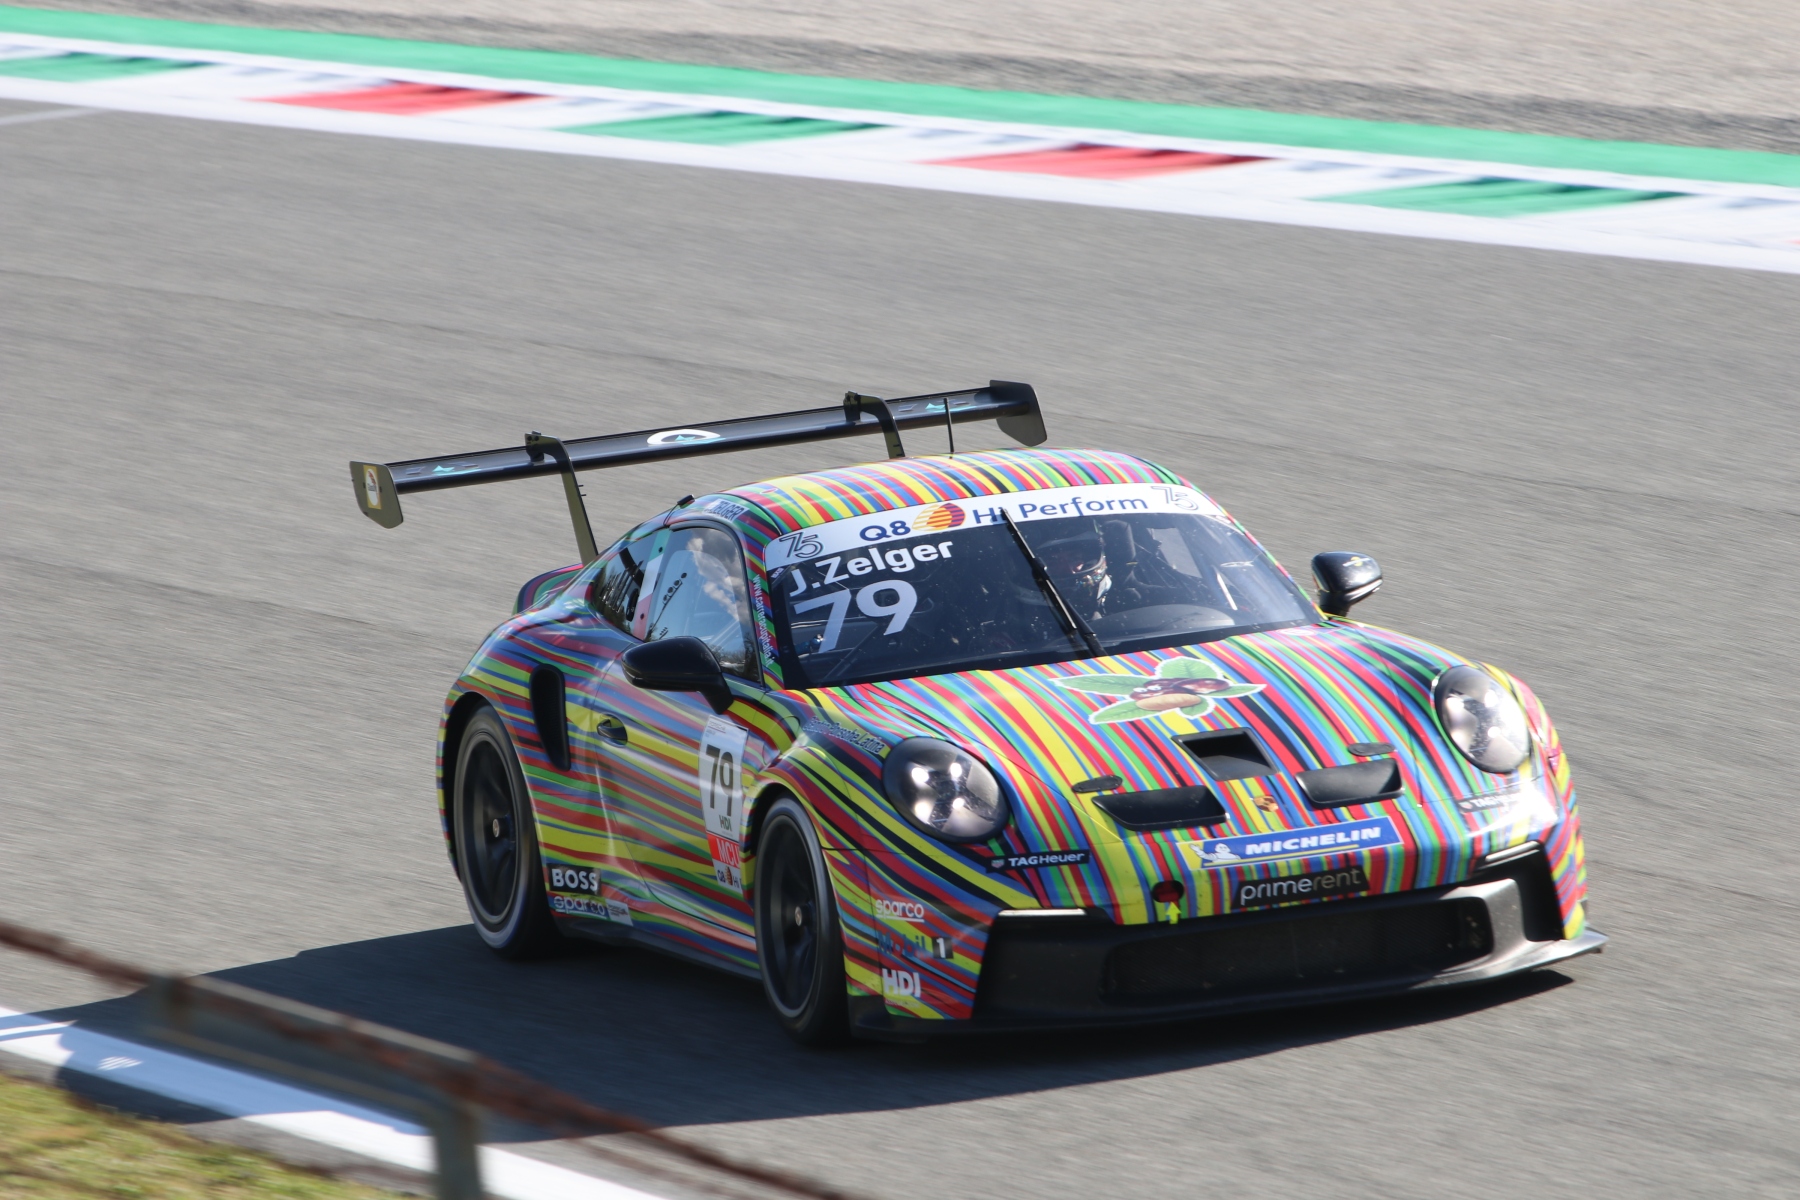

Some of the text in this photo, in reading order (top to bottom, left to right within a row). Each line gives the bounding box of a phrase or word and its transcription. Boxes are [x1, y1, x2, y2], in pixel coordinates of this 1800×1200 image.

[859, 520, 911, 542] Q8
[1019, 497, 1149, 518] Perform
[779, 532, 824, 559] 75
[789, 541, 953, 597] J.Zelger
[753, 574, 774, 668] www.carreracupitalia.it
[793, 579, 918, 654] 79
[706, 744, 733, 817] 79
[1246, 827, 1381, 855] MICHELIN
[552, 868, 598, 892] BOSS
[1240, 868, 1361, 905] primerent
[554, 896, 605, 916] sparco
[875, 899, 925, 918] sparco
[882, 968, 921, 997] HDI
